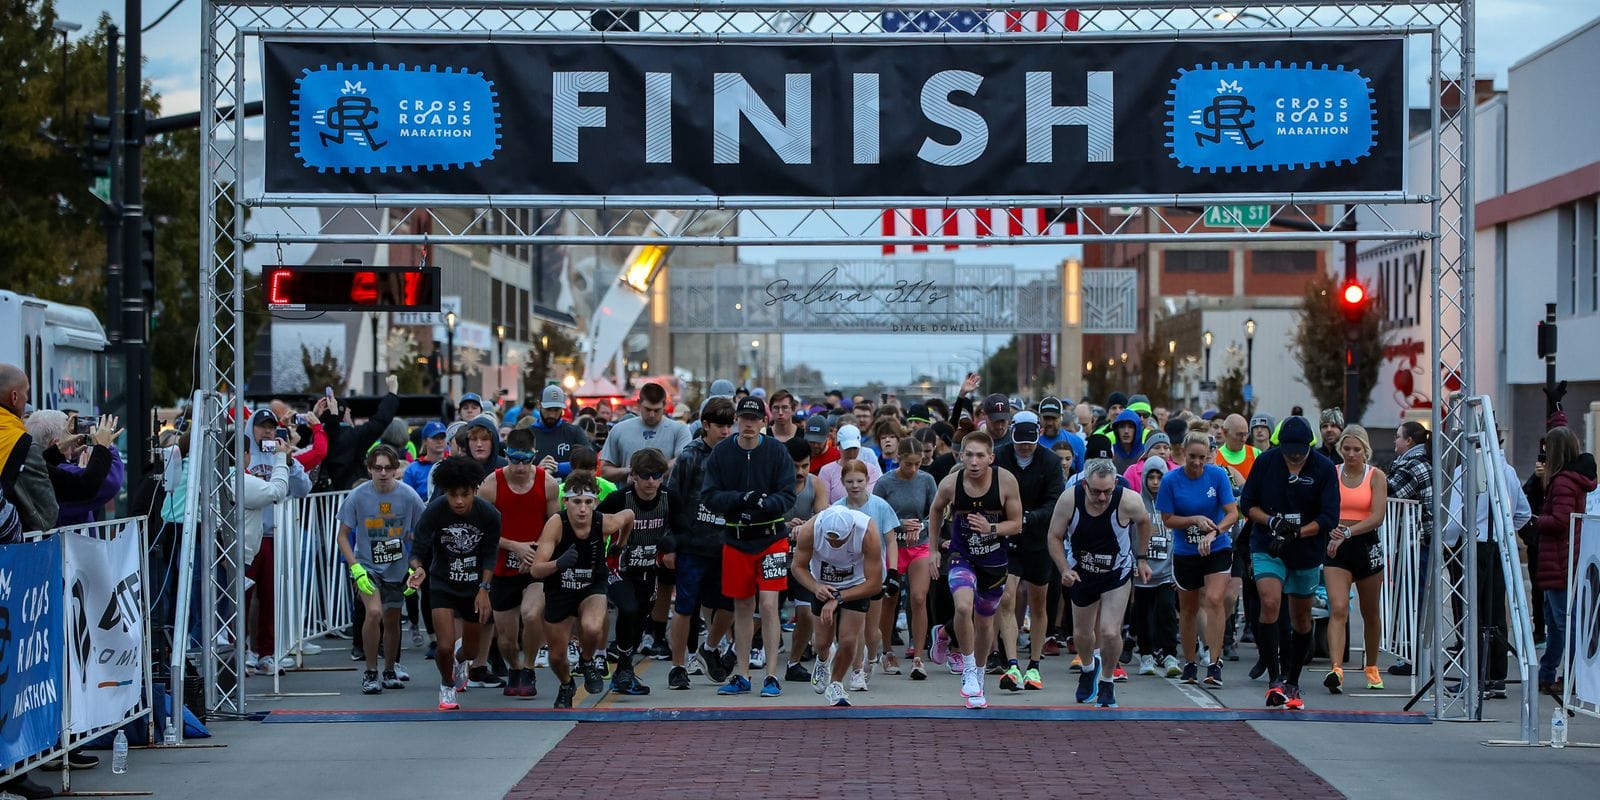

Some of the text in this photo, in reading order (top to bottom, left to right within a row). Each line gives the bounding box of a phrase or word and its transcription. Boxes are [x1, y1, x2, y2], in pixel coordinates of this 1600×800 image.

[399, 100, 471, 111] CROSS
[1275, 98, 1348, 109] CROSS
[399, 114, 471, 125] ROADS
[552, 69, 1114, 167] FINISH
[1275, 112, 1348, 122] ROADS
[400, 129, 471, 137] MARATHON
[1277, 126, 1348, 135] MARATHON
[1209, 205, 1264, 224] Ash ST
[764, 267, 872, 307] Salina
[892, 324, 977, 332] DIANE DOWELL
[696, 512, 716, 523] 3069
[374, 553, 393, 563] 3195
[449, 571, 469, 581] 3173
